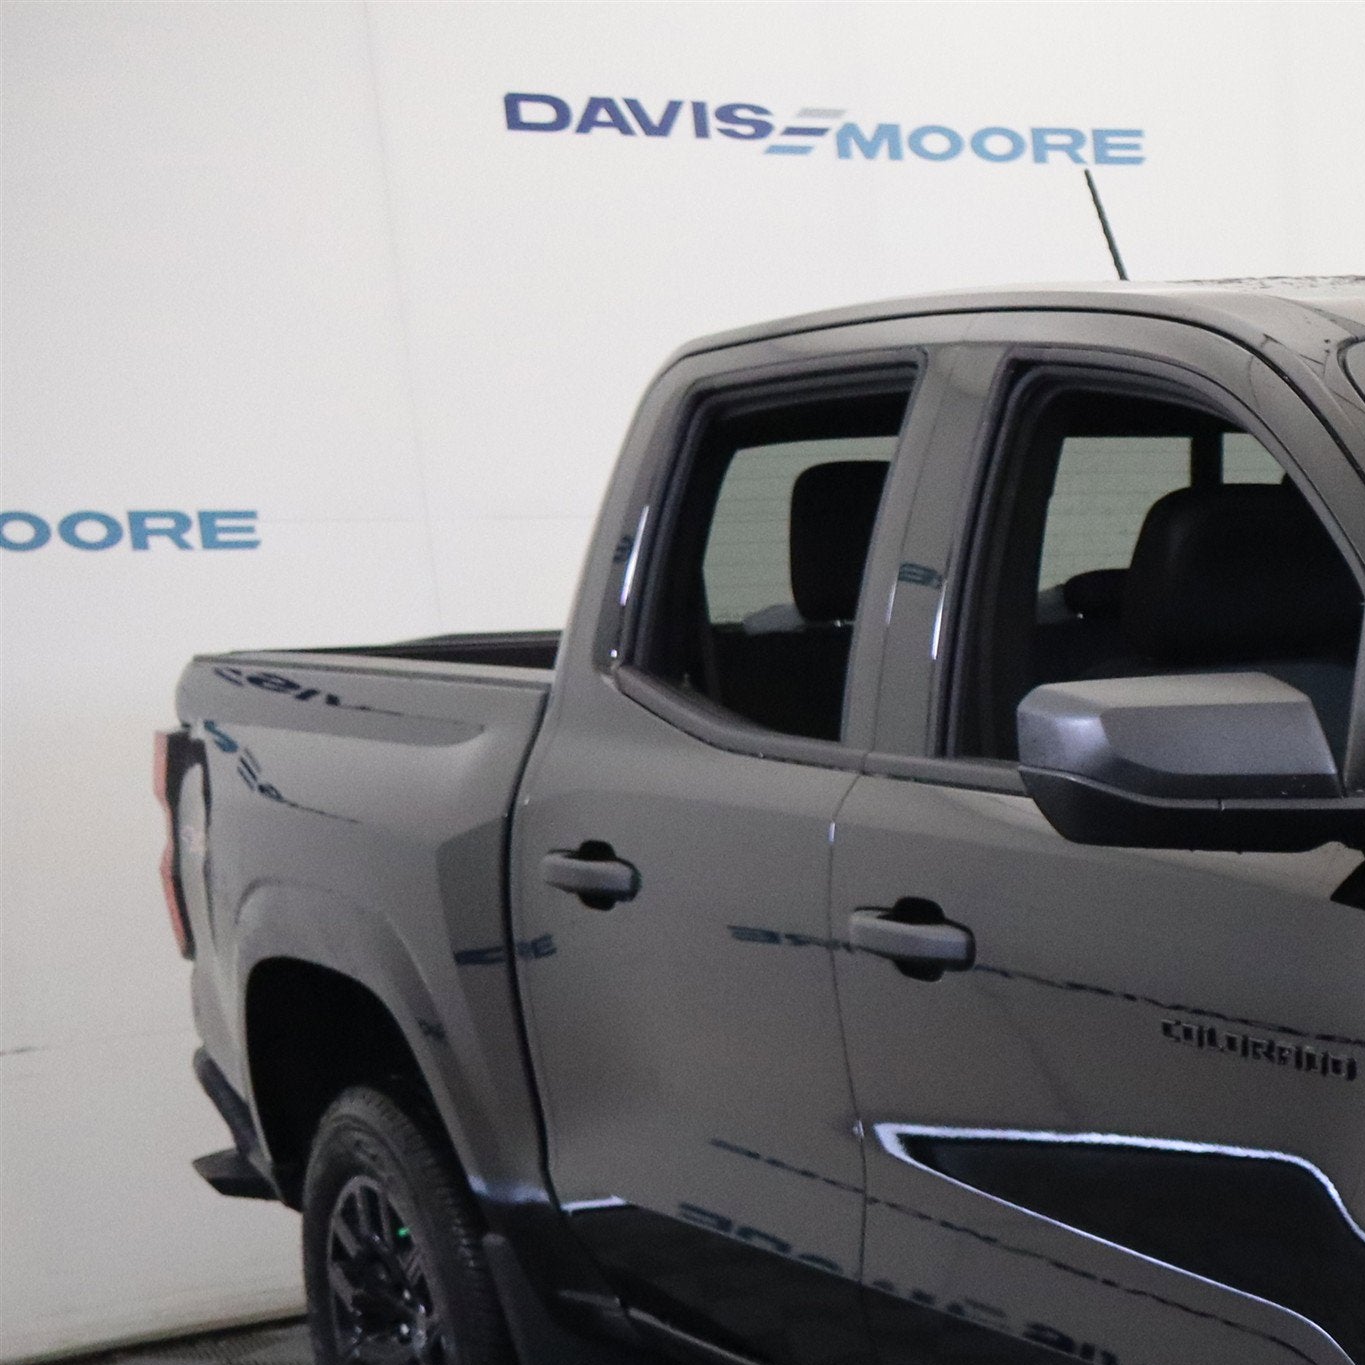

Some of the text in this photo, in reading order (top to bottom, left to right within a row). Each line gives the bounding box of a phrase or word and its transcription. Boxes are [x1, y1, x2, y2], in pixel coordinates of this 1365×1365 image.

[502, 92, 1147, 167] DAVIS MOORE
[1160, 1018, 1358, 1082] COLORADO
